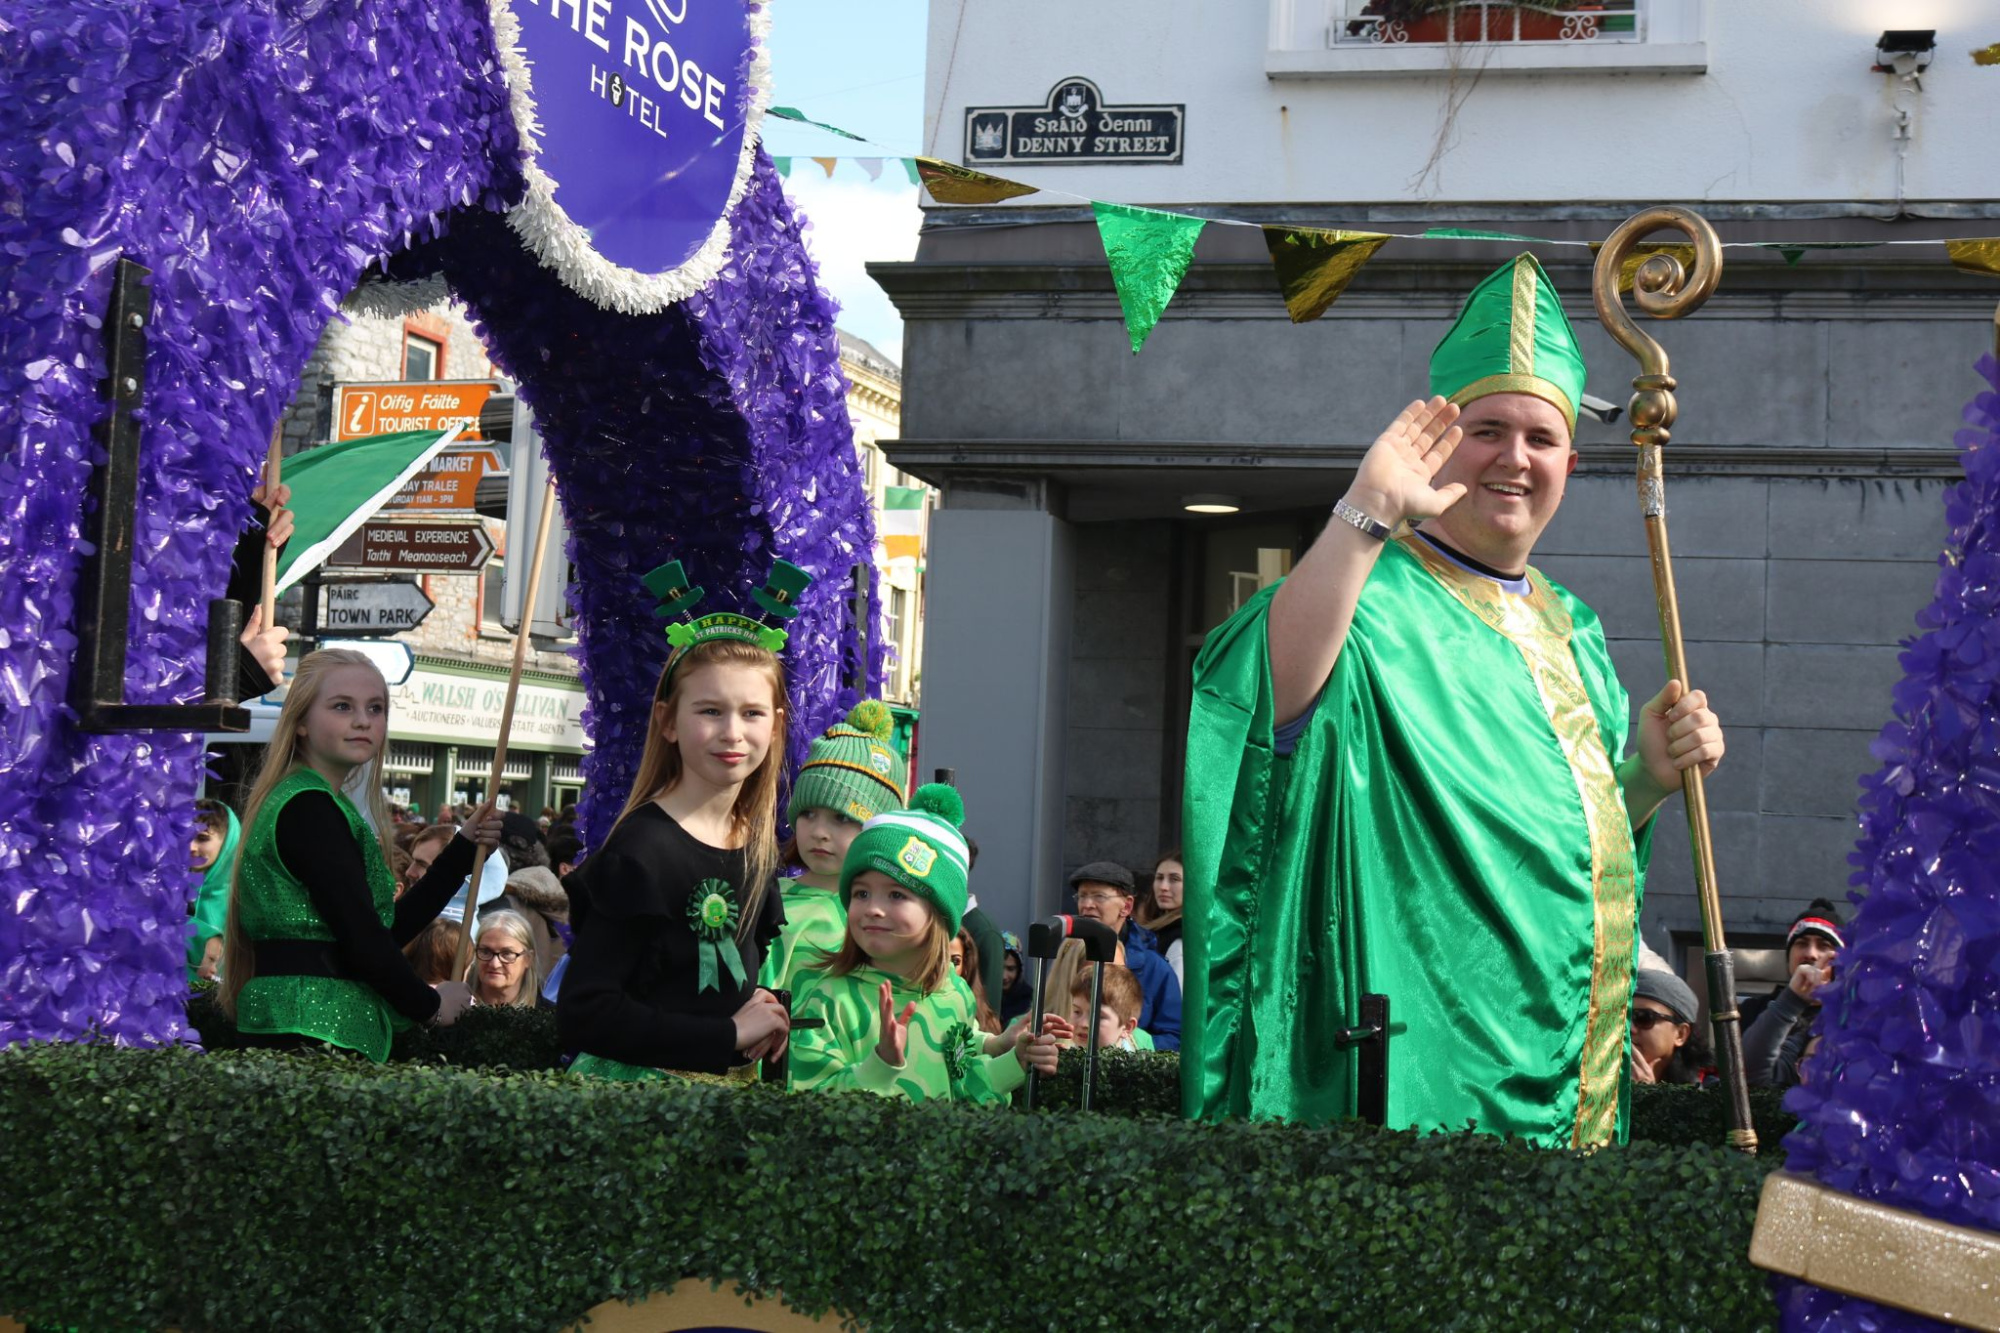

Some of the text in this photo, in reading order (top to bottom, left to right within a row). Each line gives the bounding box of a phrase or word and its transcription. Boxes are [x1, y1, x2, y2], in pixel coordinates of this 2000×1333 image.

[529, 0, 726, 131] HE ROSE
[1018, 136, 1169, 153] DENNY STREET
[380, 394, 460, 413] Oifig Fáilte
[379, 416, 480, 432] TOURIST OFFCE
[430, 456, 474, 472] MARKET
[422, 481, 459, 491] TRALEE
[367, 529, 469, 544] MEDIEVAL EXPERIENCE
[331, 586, 359, 600] PÁIRC
[331, 609, 416, 624] TOWN PARK
[701, 616, 758, 631] HAPPY
[423, 682, 569, 719] WALSH O'SLLIVAN
[411, 710, 466, 726] AUCTIONEERS
[511, 720, 535, 733] STATE
[538, 723, 566, 736] AGENTS
